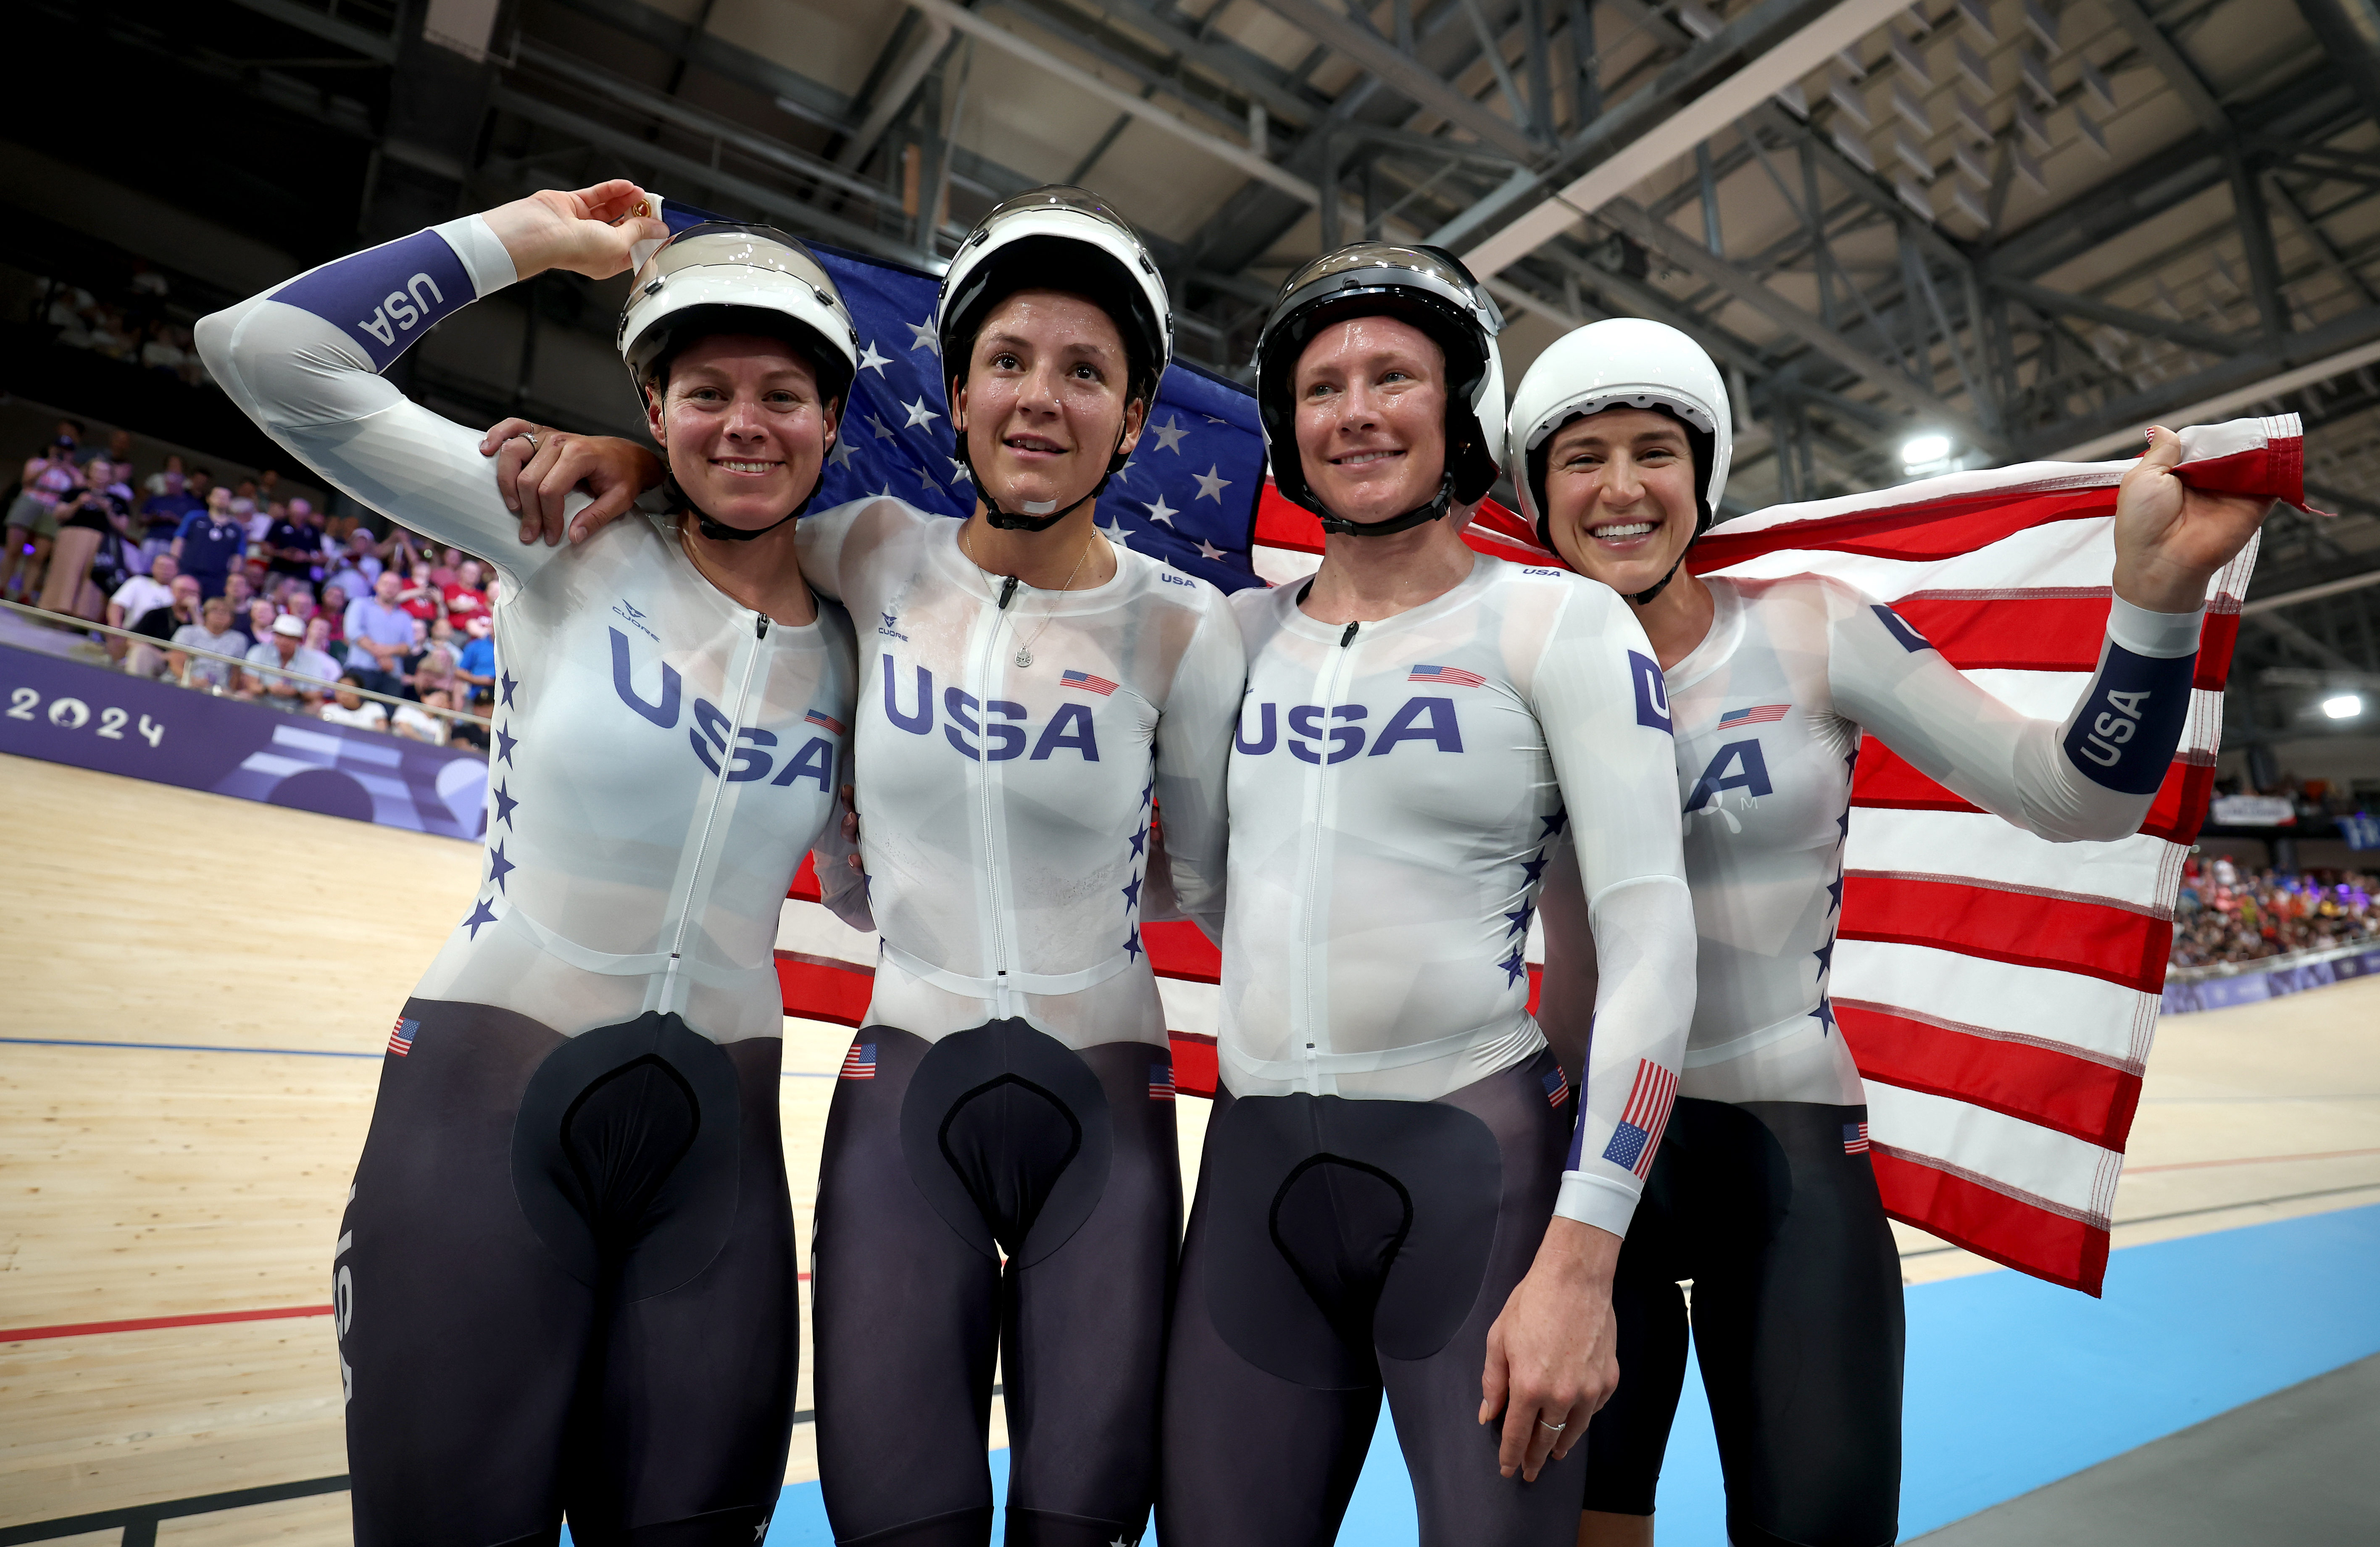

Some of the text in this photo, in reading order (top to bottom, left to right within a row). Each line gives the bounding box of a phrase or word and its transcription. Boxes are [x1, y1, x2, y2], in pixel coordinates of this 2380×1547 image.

[358, 272, 444, 347] USA
[1161, 573, 1197, 589] USA
[1522, 568, 1561, 577] USA
[612, 605, 661, 643] CUORE
[878, 627, 908, 642] CUORE
[5, 687, 166, 748] 2024
[608, 625, 833, 793] USA
[883, 653, 1100, 762] USA
[1235, 696, 1464, 765] USA
[2080, 689, 2151, 767] USA
